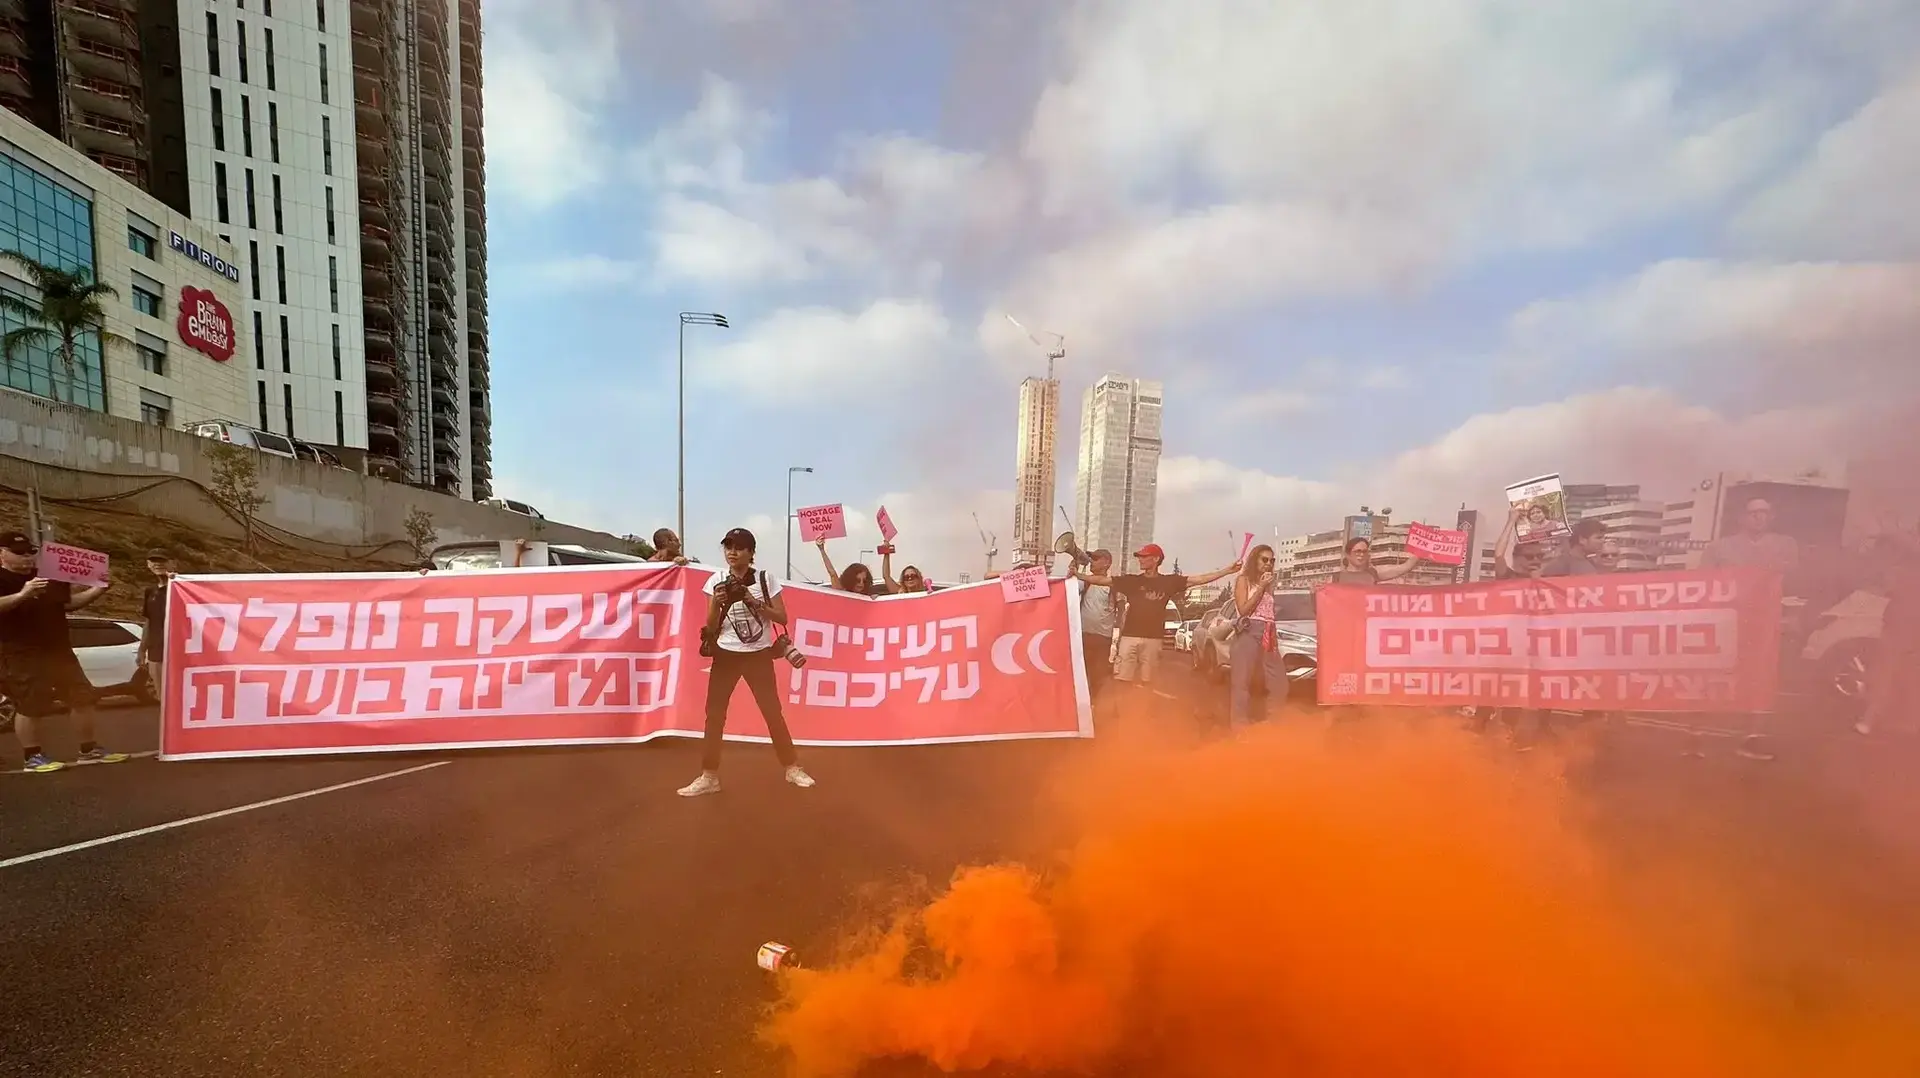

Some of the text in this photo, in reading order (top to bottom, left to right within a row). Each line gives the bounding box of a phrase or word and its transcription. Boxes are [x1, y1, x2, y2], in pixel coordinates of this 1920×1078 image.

[173, 235, 237, 281] FIRON
[197, 300, 227, 335] BRAIN
[800, 506, 841, 518] HOSTAGE
[809, 517, 833, 525] DEAL
[812, 524, 833, 532] NOW
[46, 545, 106, 564] HOSTAGE
[59, 557, 94, 569] DEAL
[59, 565, 91, 577] NOW
[1003, 568, 1045, 582] HOSTAGE
[1015, 584, 1037, 593] NOW
[1365, 578, 1738, 615] עסקה או גזר דין מוות
[184, 588, 685, 655] העסקה נופלת
[794, 615, 978, 661] העיניים
[1379, 622, 1722, 658] בוחרות בחיים
[189, 653, 672, 722] המדינה בוערת
[788, 661, 981, 708] עליכם!
[1365, 672, 1529, 698] החטופים
[1539, 673, 1603, 701] את
[1616, 671, 1740, 701] הצילו
